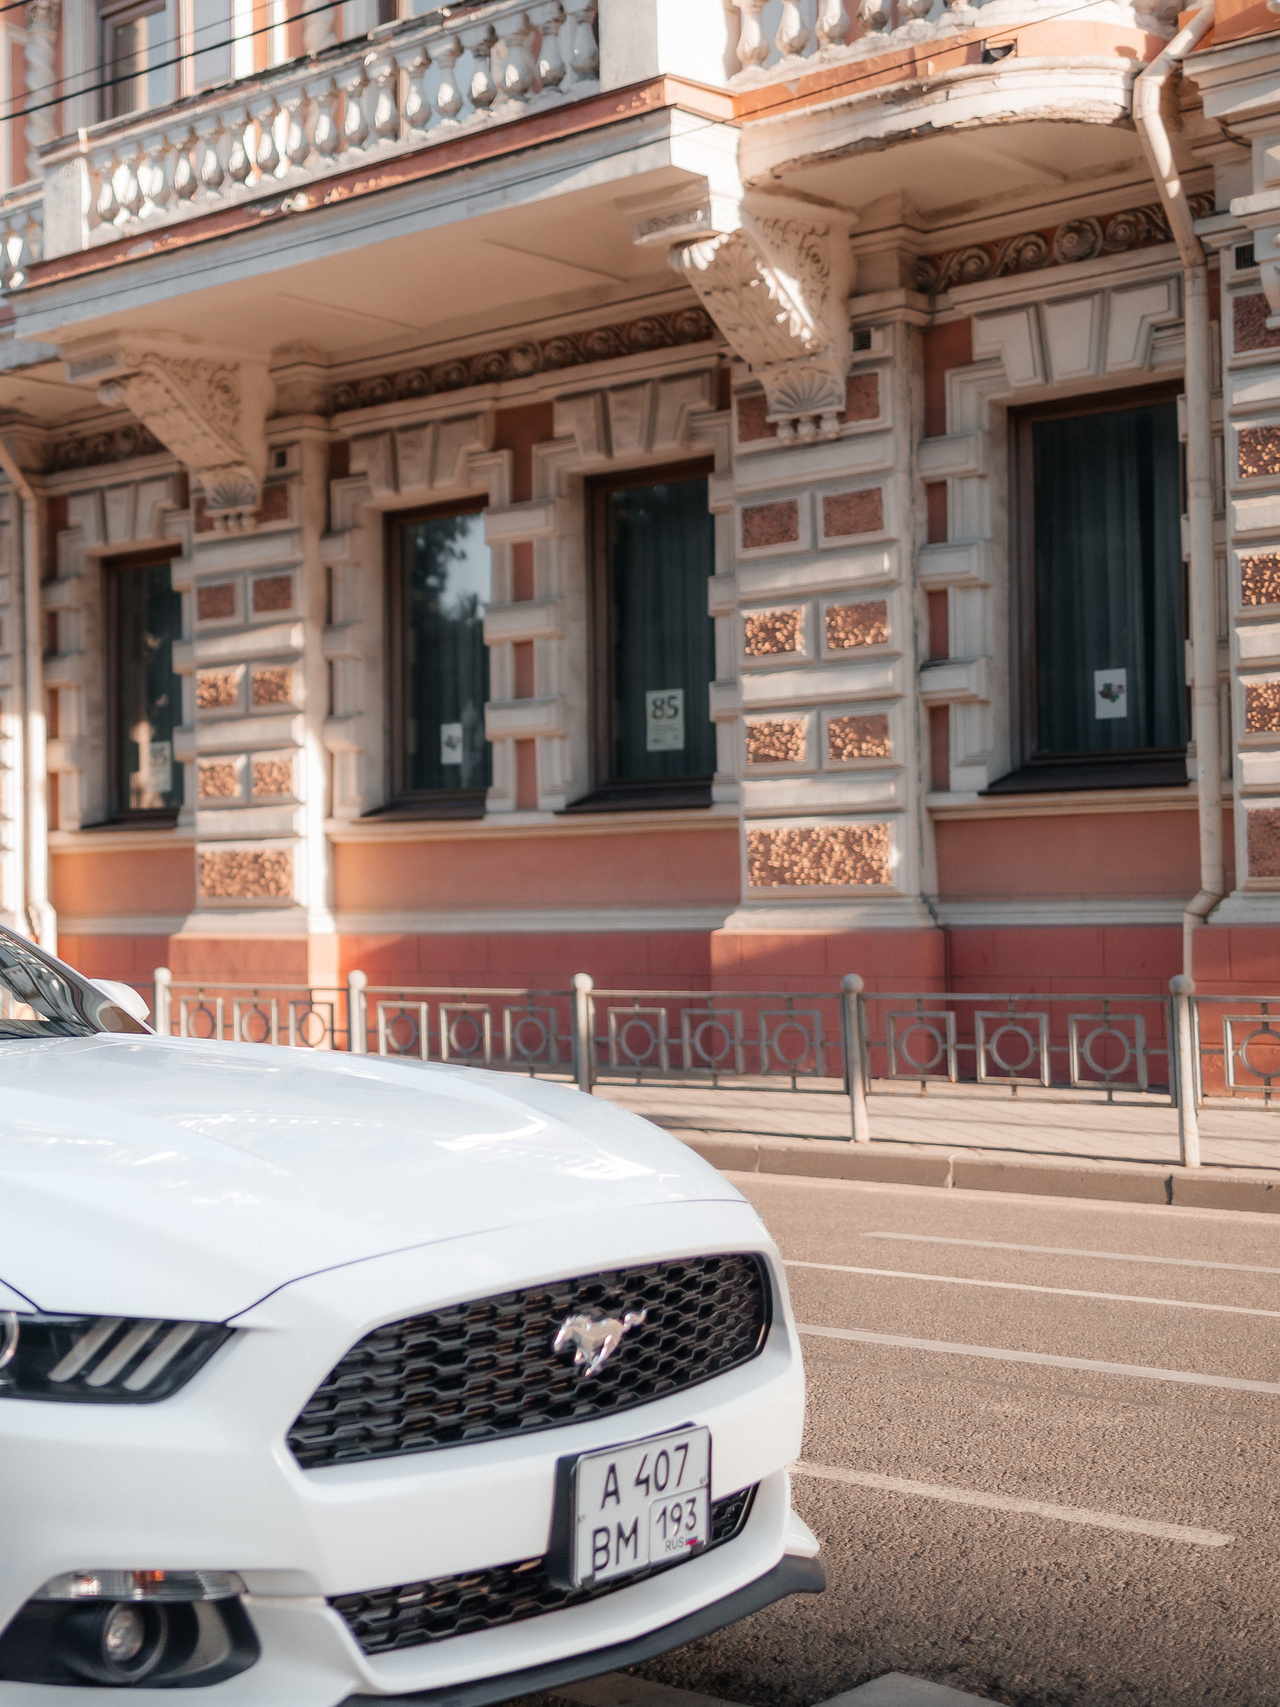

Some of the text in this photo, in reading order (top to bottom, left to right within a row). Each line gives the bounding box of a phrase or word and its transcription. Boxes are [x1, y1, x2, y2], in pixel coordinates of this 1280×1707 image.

[652, 695, 679, 720] 85
[634, 1441, 690, 1497] 407
[655, 1496, 698, 1540] 193
[664, 1536, 685, 1553] RUS
